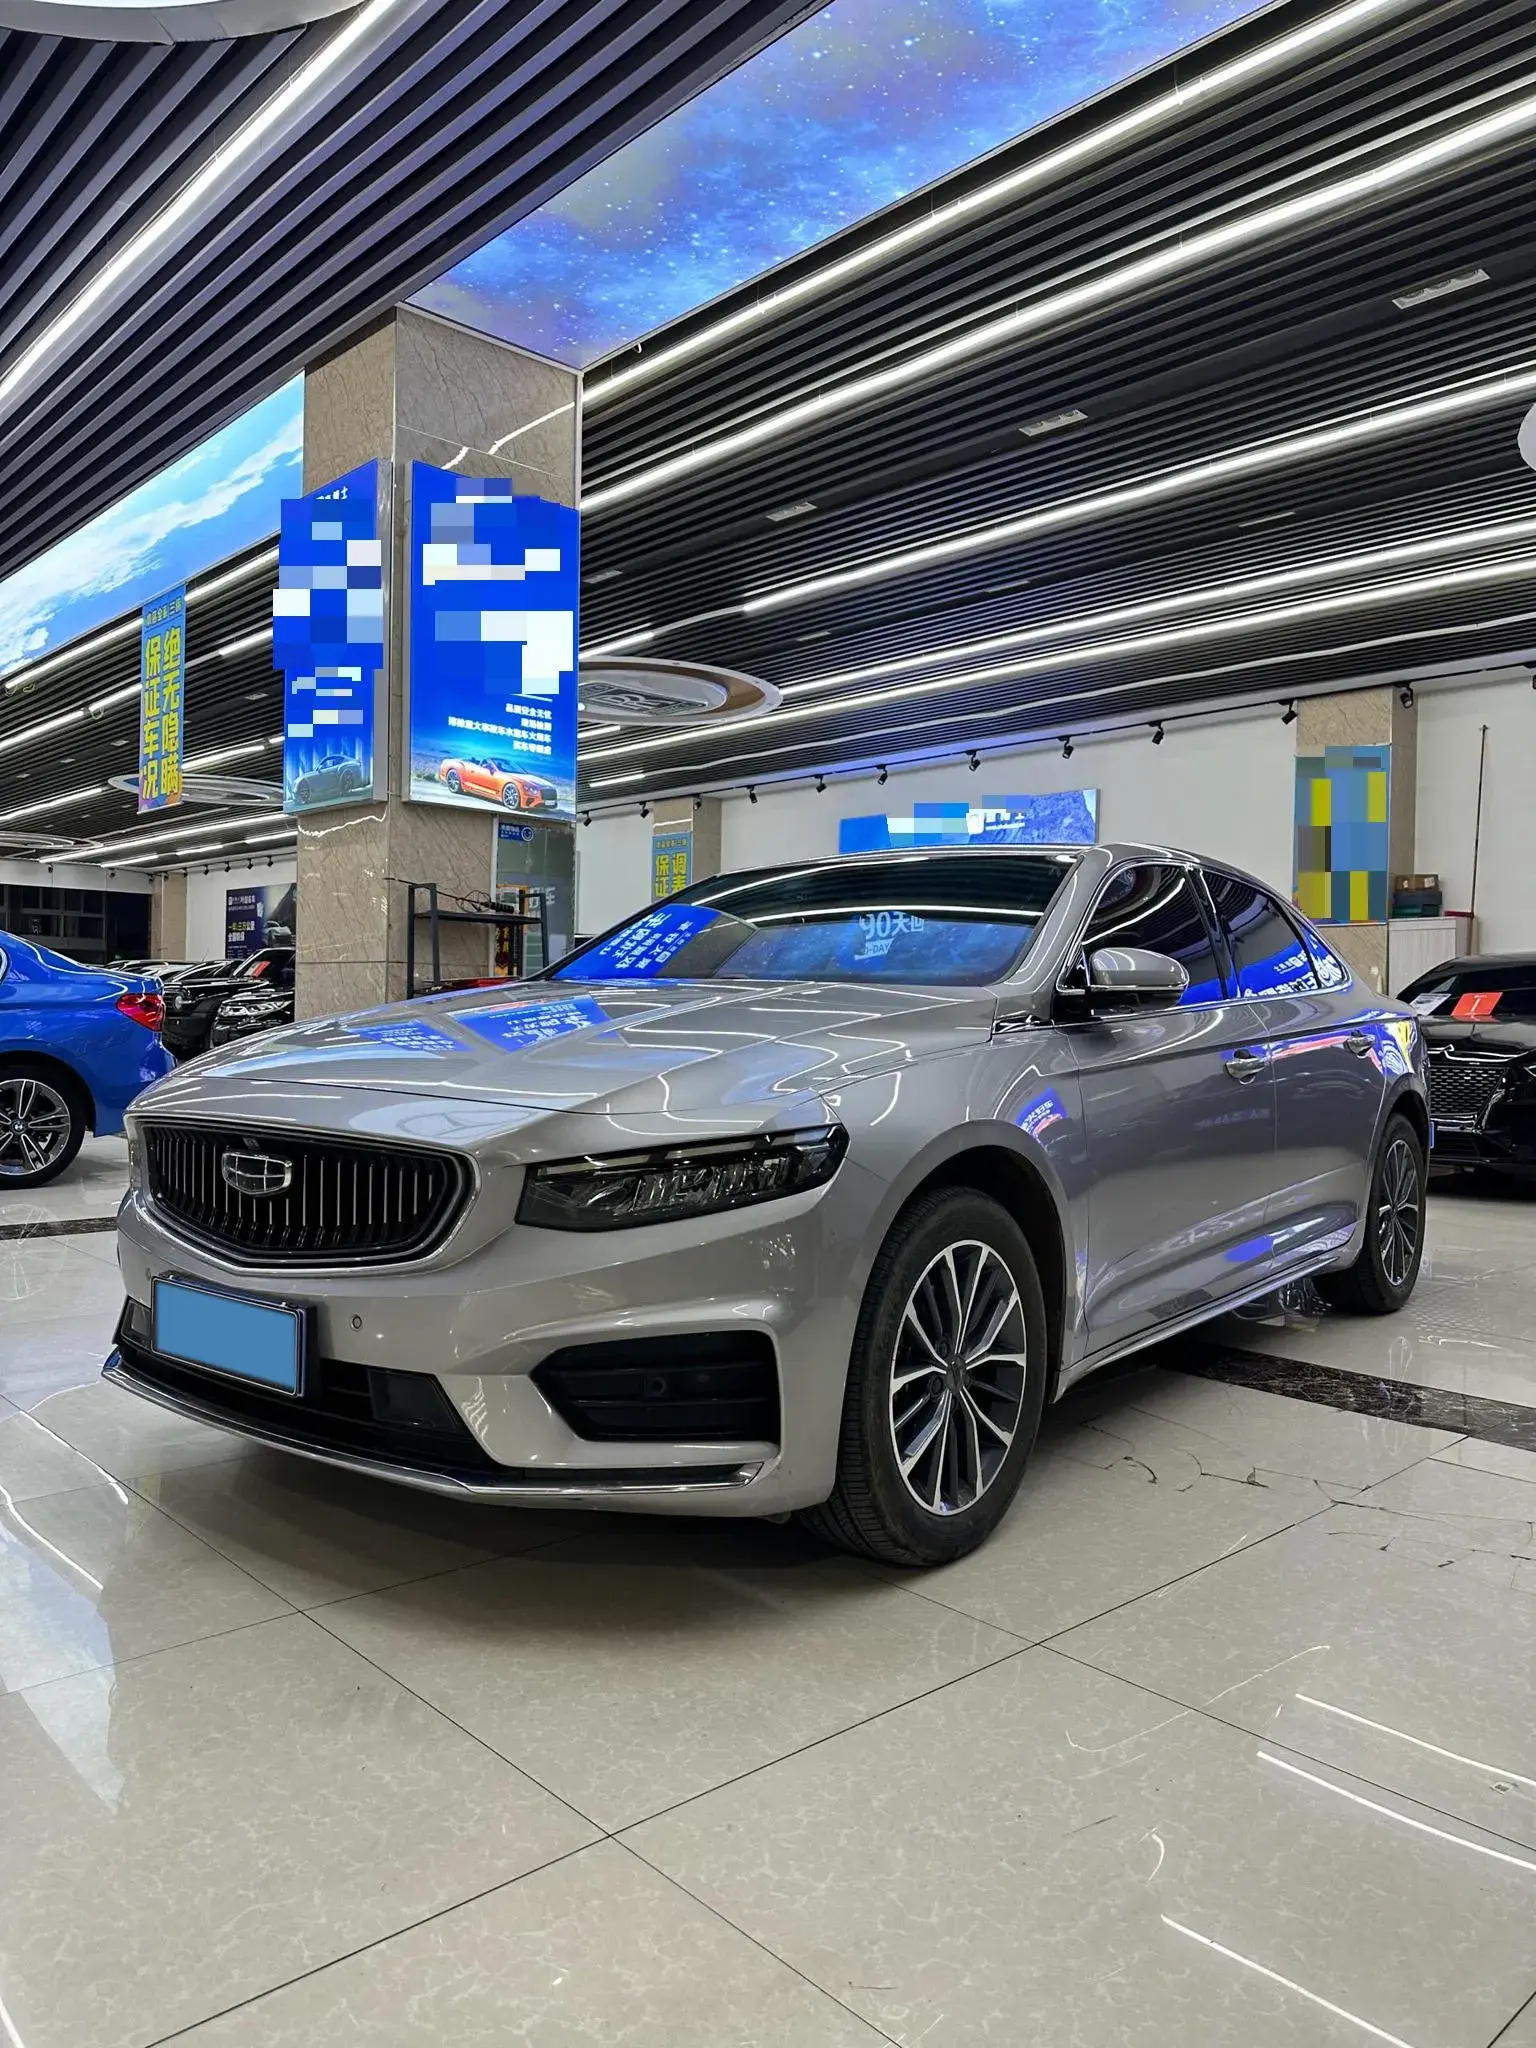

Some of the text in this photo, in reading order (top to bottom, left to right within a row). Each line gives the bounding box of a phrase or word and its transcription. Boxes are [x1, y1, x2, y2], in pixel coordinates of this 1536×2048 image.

[142, 636, 161, 799] 保证车况
[161, 627, 181, 796] 绝无隐瞒
[655, 854, 669, 898] 保证
